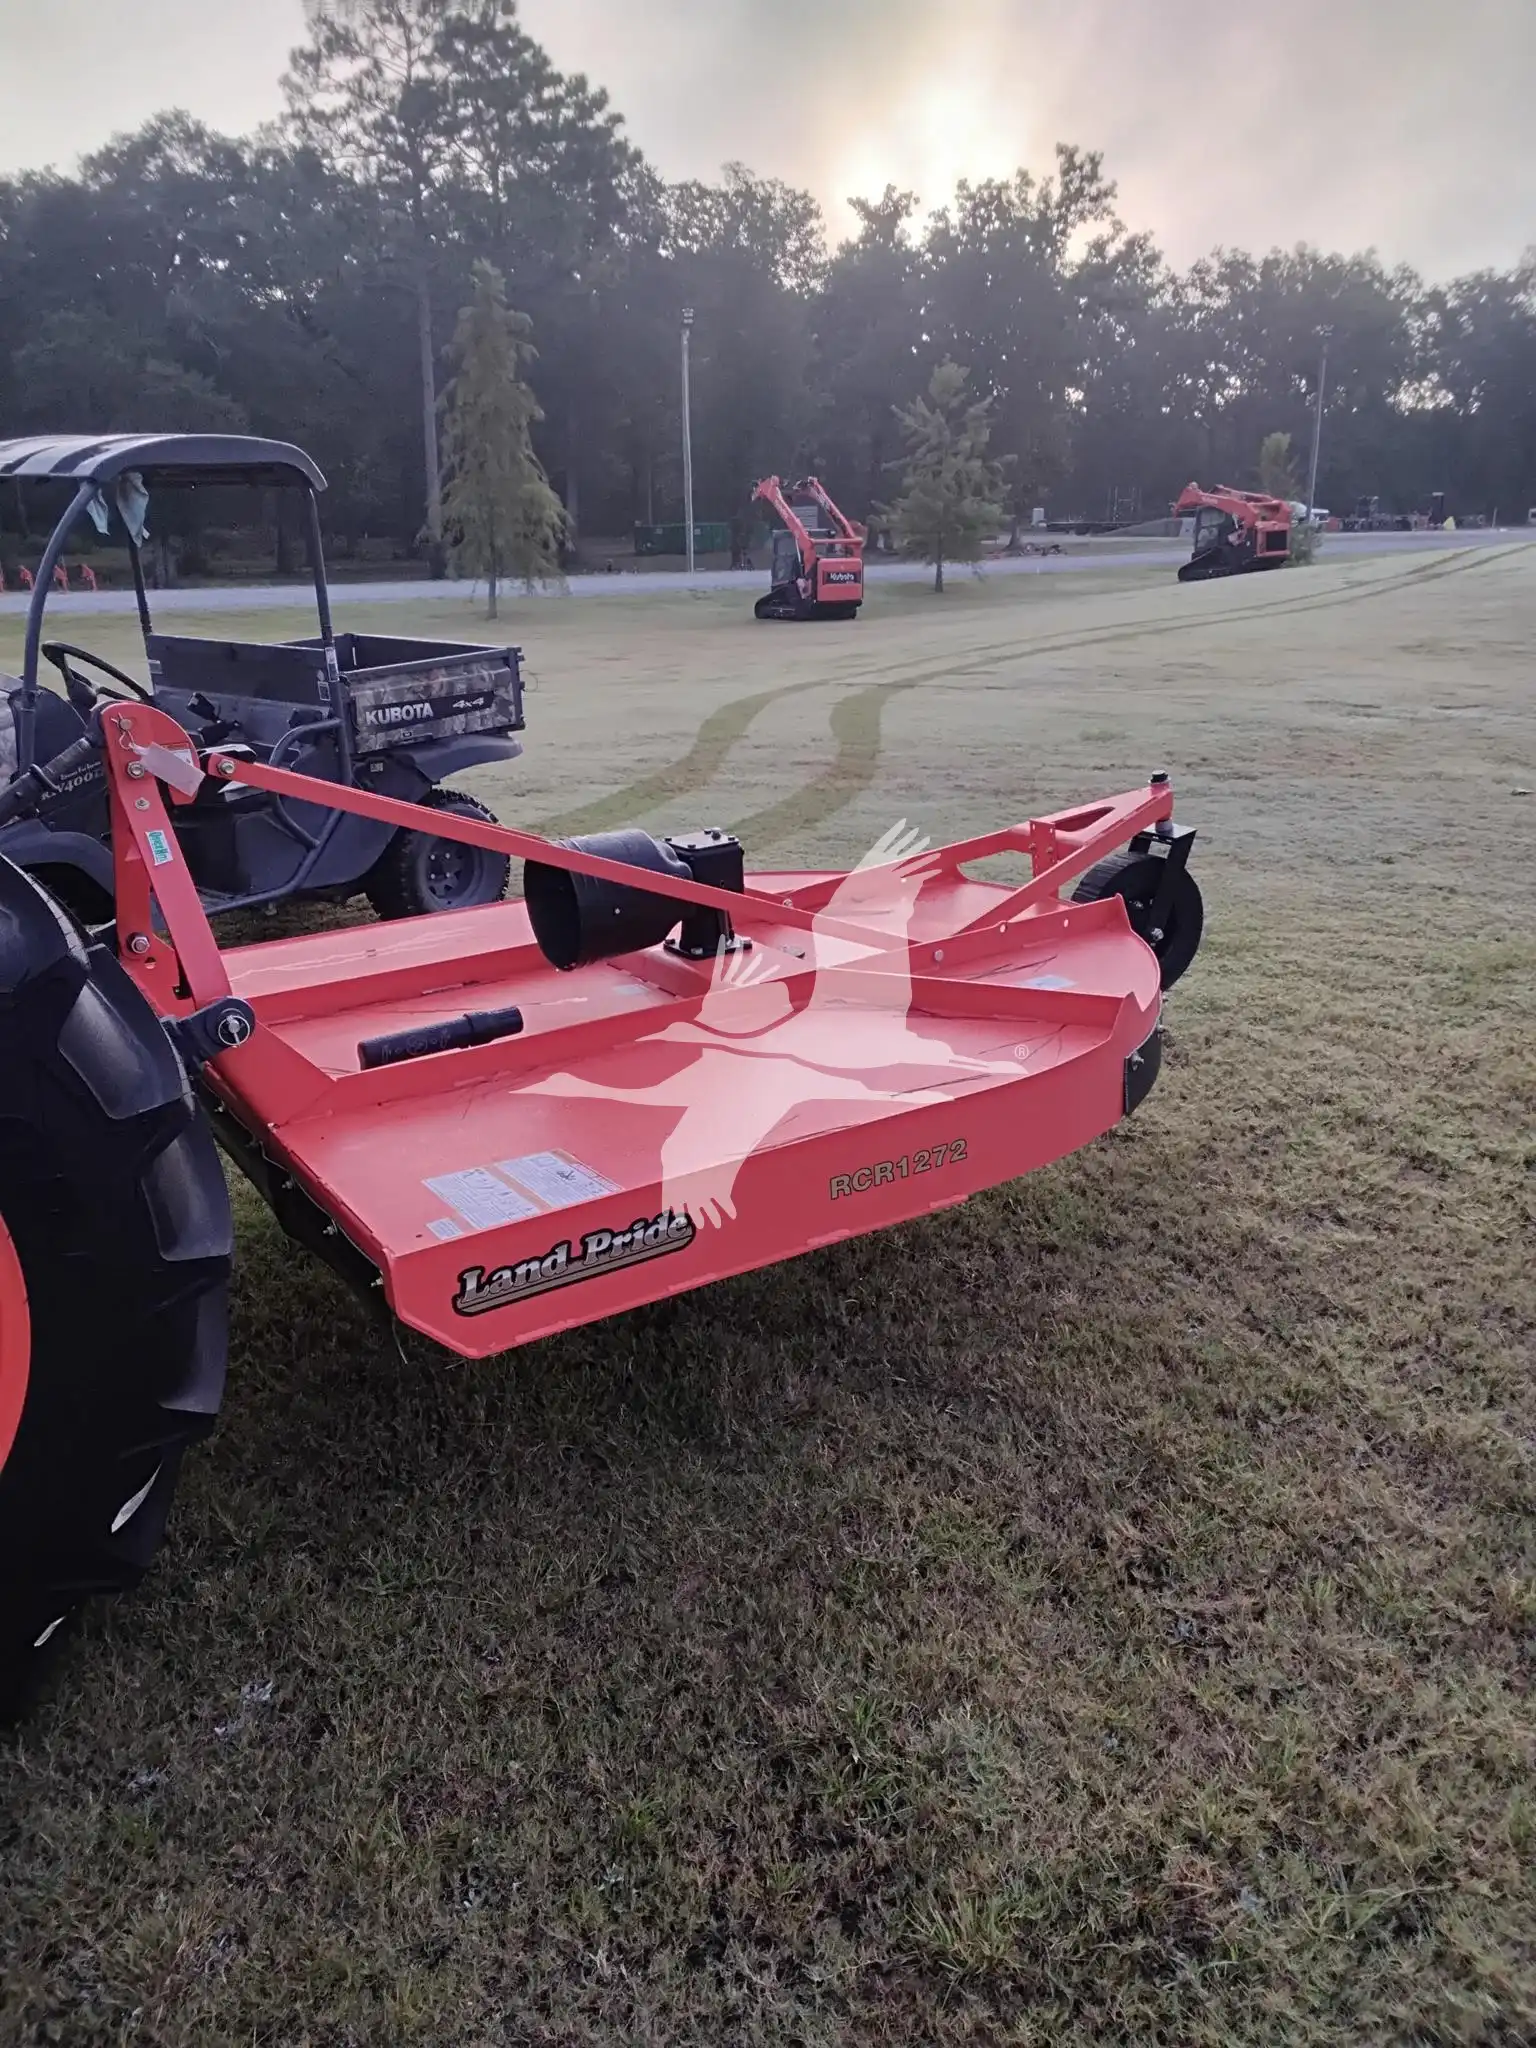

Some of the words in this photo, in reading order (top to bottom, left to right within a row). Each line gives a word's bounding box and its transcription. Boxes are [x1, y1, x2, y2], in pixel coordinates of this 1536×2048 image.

[365, 702, 434, 726] KUBOTA
[452, 697, 485, 709] 4x4
[829, 1138, 968, 1200] RCR1272
[458, 1243, 569, 1304] Land
[583, 1209, 693, 1266] Pride
